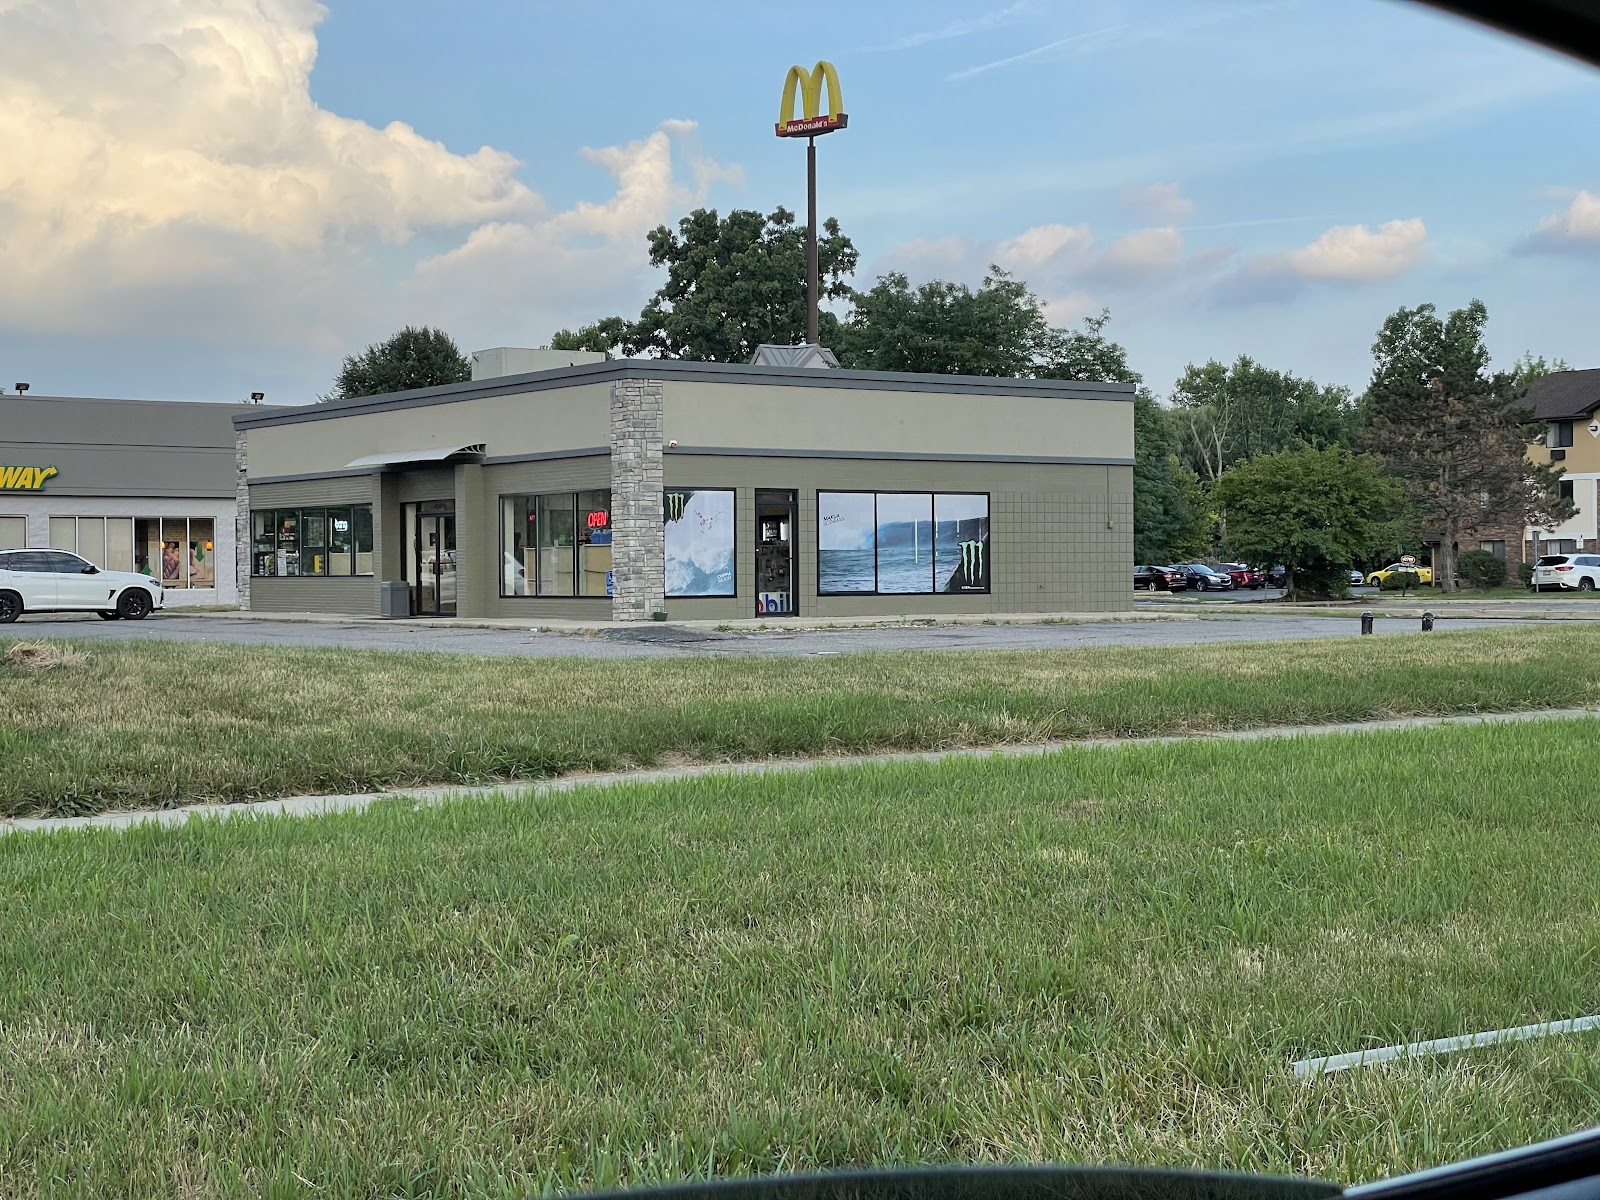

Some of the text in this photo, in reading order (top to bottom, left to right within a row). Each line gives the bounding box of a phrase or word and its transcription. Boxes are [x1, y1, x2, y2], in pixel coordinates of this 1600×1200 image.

[786, 121, 828, 133] McDonald's
[0, 466, 58, 489] WAY
[587, 511, 607, 527] OPEN
